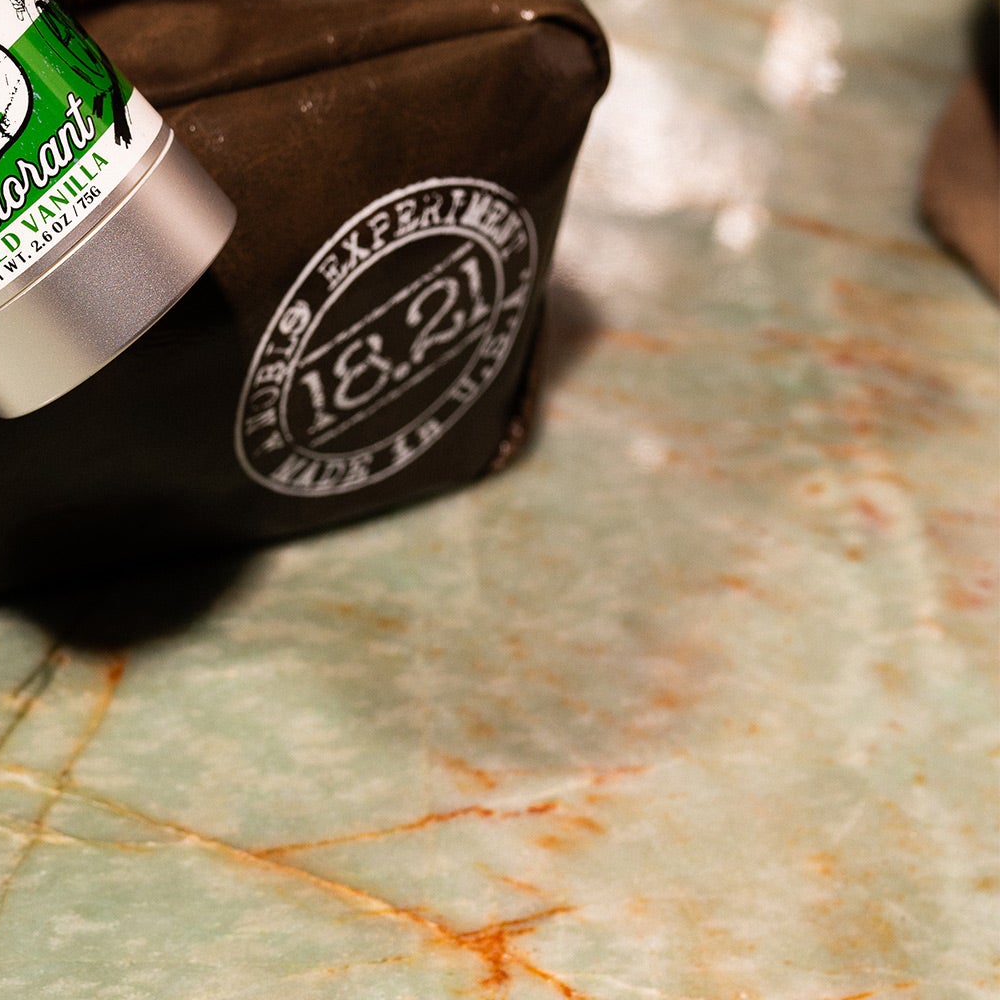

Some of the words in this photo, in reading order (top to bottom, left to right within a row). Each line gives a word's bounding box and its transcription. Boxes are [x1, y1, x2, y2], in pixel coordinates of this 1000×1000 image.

[3, 250, 32, 273] WT.
[30, 230, 53, 253] 2.6
[51, 212, 73, 234] OZ
[76, 184, 102, 210] 75G
[20, 151, 109, 234] VANILLA
[299, 255, 491, 435] 18.21
